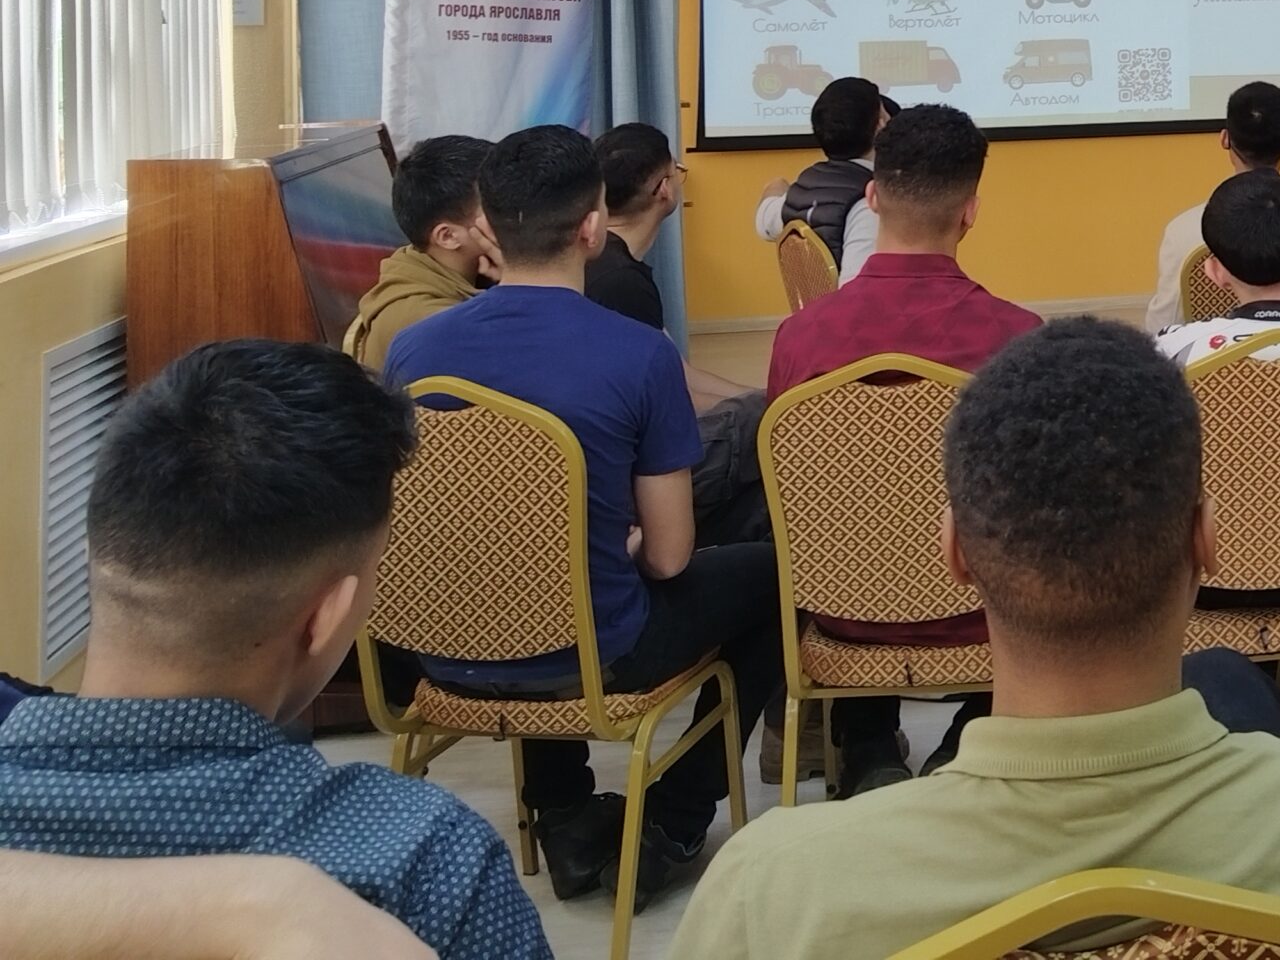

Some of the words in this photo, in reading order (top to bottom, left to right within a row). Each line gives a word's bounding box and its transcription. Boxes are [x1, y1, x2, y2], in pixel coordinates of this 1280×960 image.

[438, 4, 486, 20] ГОРОДА
[489, 6, 561, 21] ЯРОСЛАВЛЯ
[1018, 10, 1100, 26] Мотоцикл
[752, 18, 829, 34] Самолёт
[889, 14, 962, 32] Вертолёт
[446, 30, 470, 40] 1955
[482, 33, 499, 43] год
[501, 33, 553, 43] основания
[1009, 93, 1080, 108] Автодом
[754, 102, 812, 119] Тракто
